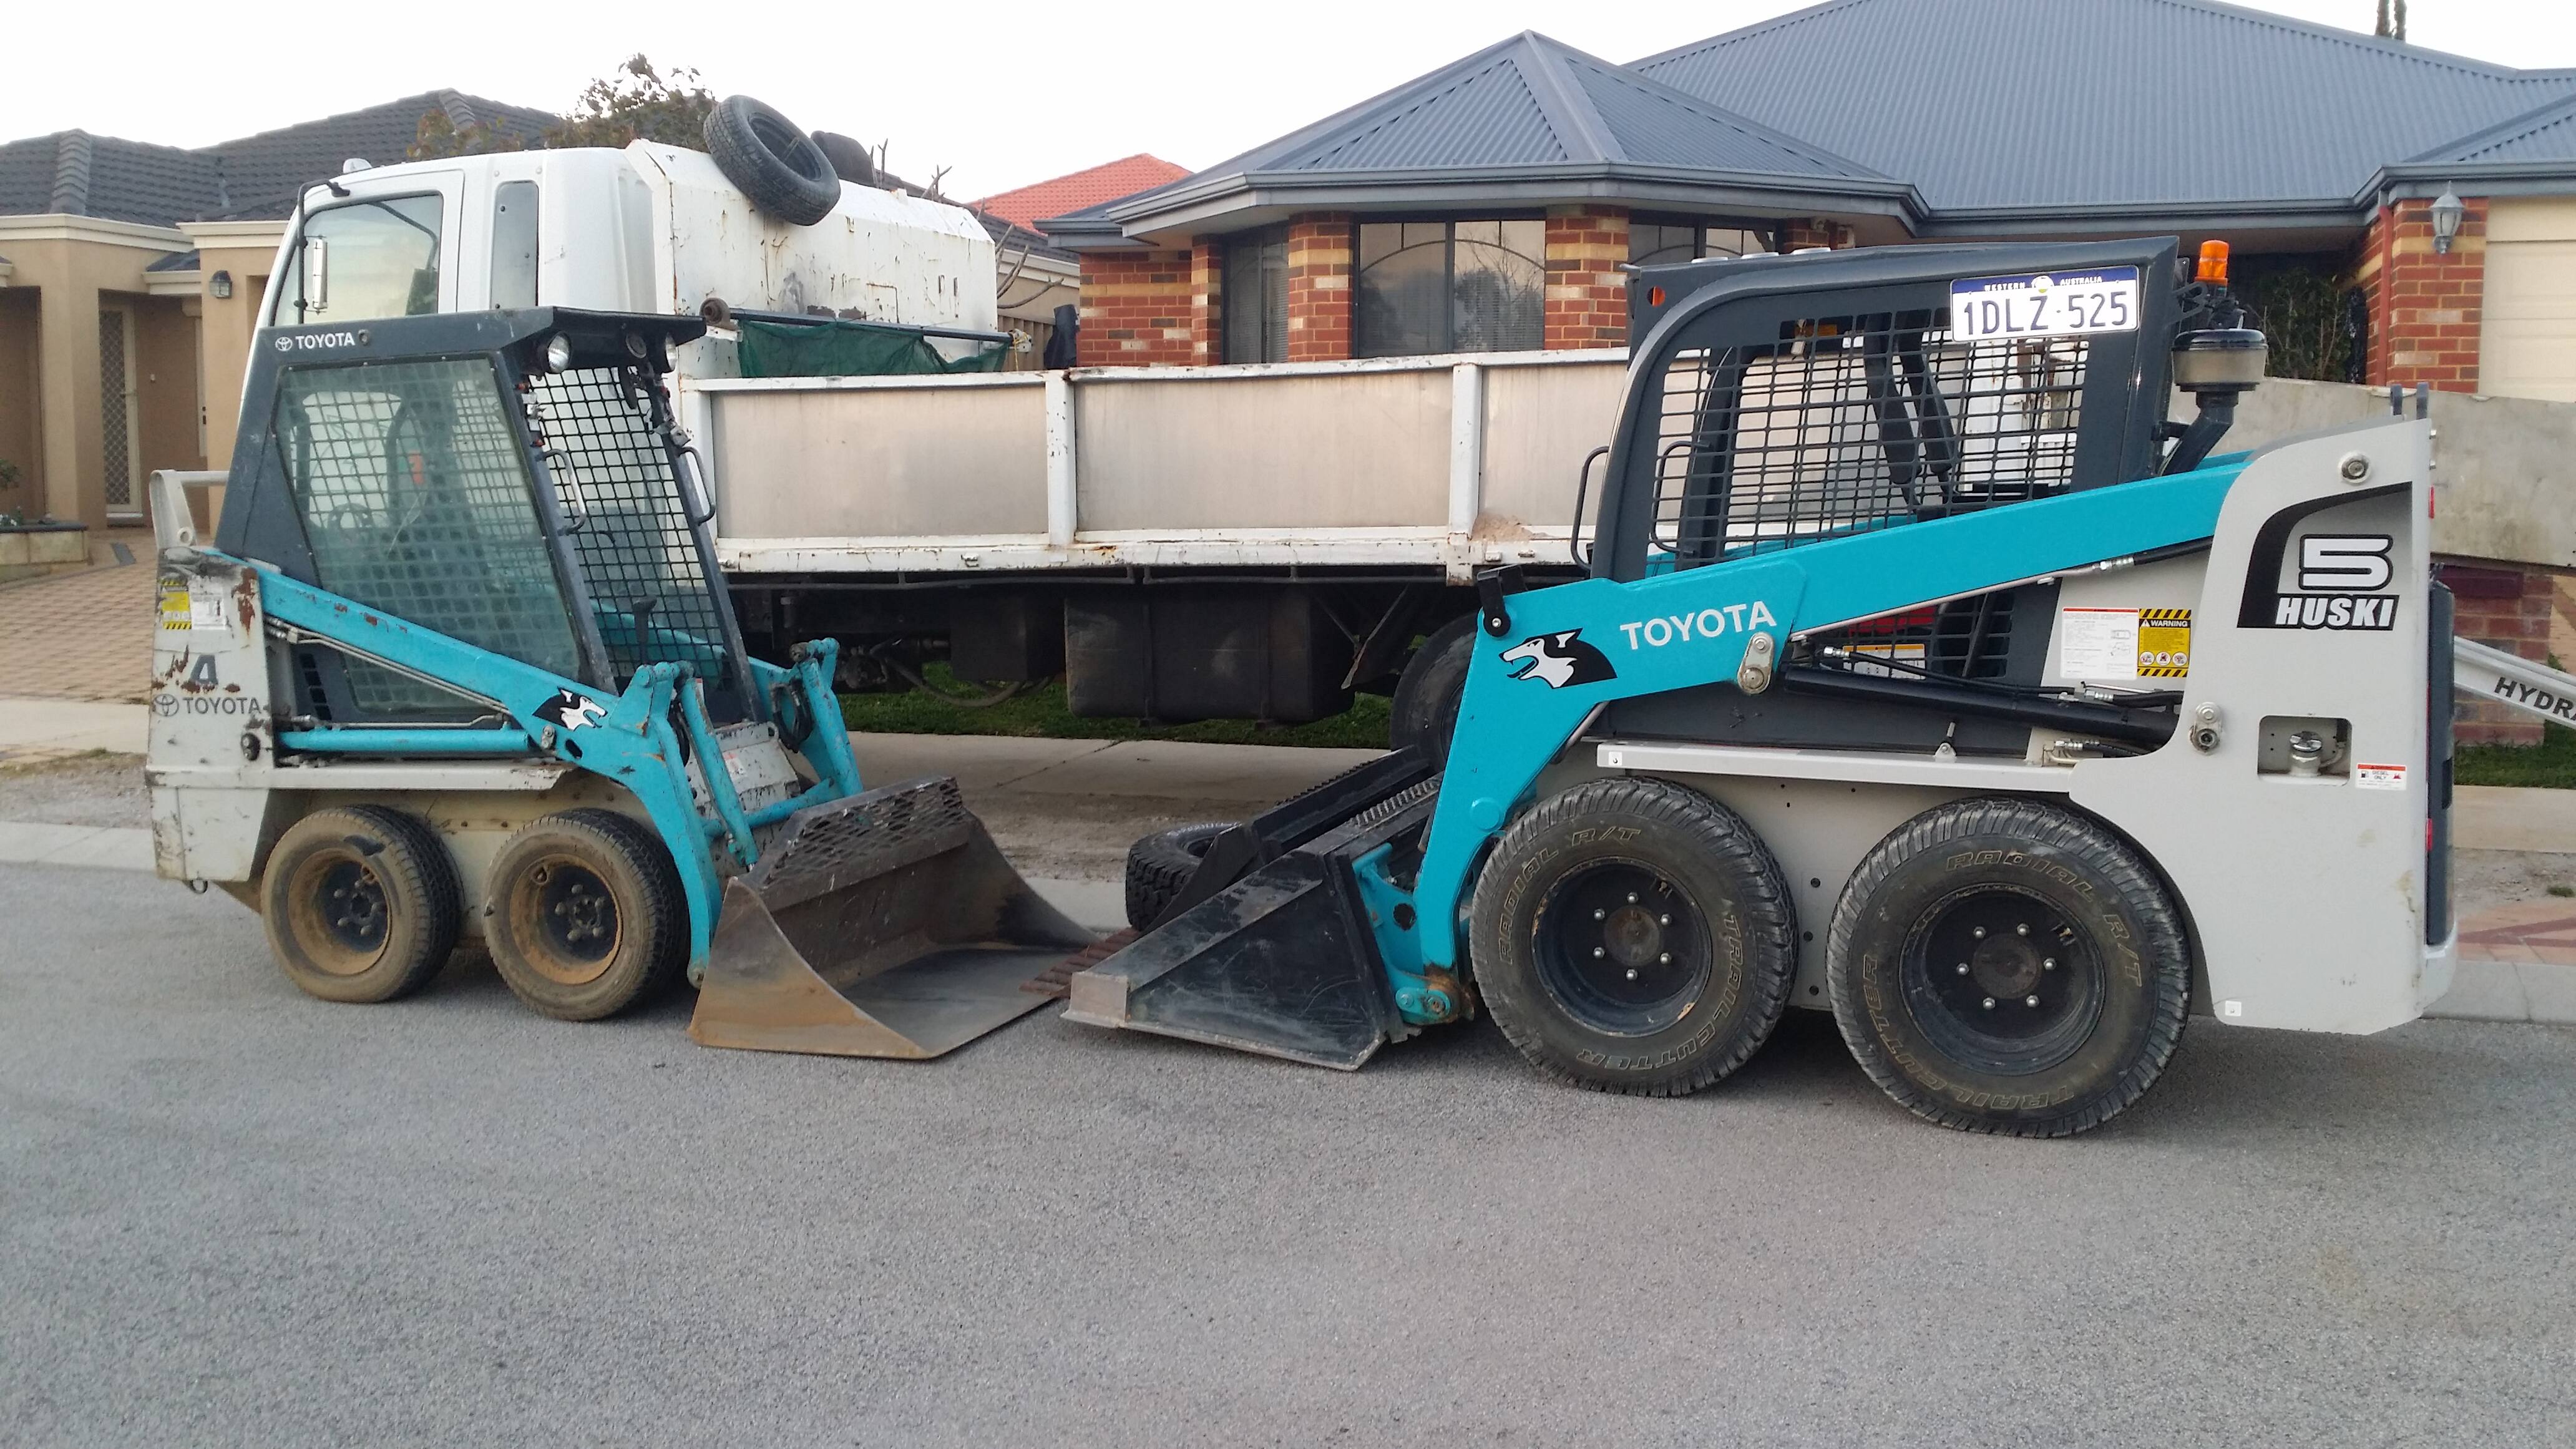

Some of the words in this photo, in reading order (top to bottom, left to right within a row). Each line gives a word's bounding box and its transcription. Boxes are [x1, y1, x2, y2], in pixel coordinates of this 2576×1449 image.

[1984, 281, 2026, 291] WESTERN
[2060, 276, 2102, 286] AUSTRALIA
[296, 331, 354, 349] TOYOTA
[2301, 536, 2392, 588] 5
[1620, 600, 1777, 650] TOYOTA
[2275, 597, 2394, 627] HUSKI
[182, 696, 262, 715] TOYOTA
[2494, 676, 2576, 721] HYDR
[1498, 847, 1559, 965] RADIAL
[1571, 826, 1641, 847] R/T
[1945, 850, 2097, 903] RADIAL
[2102, 914, 2142, 987] R/T
